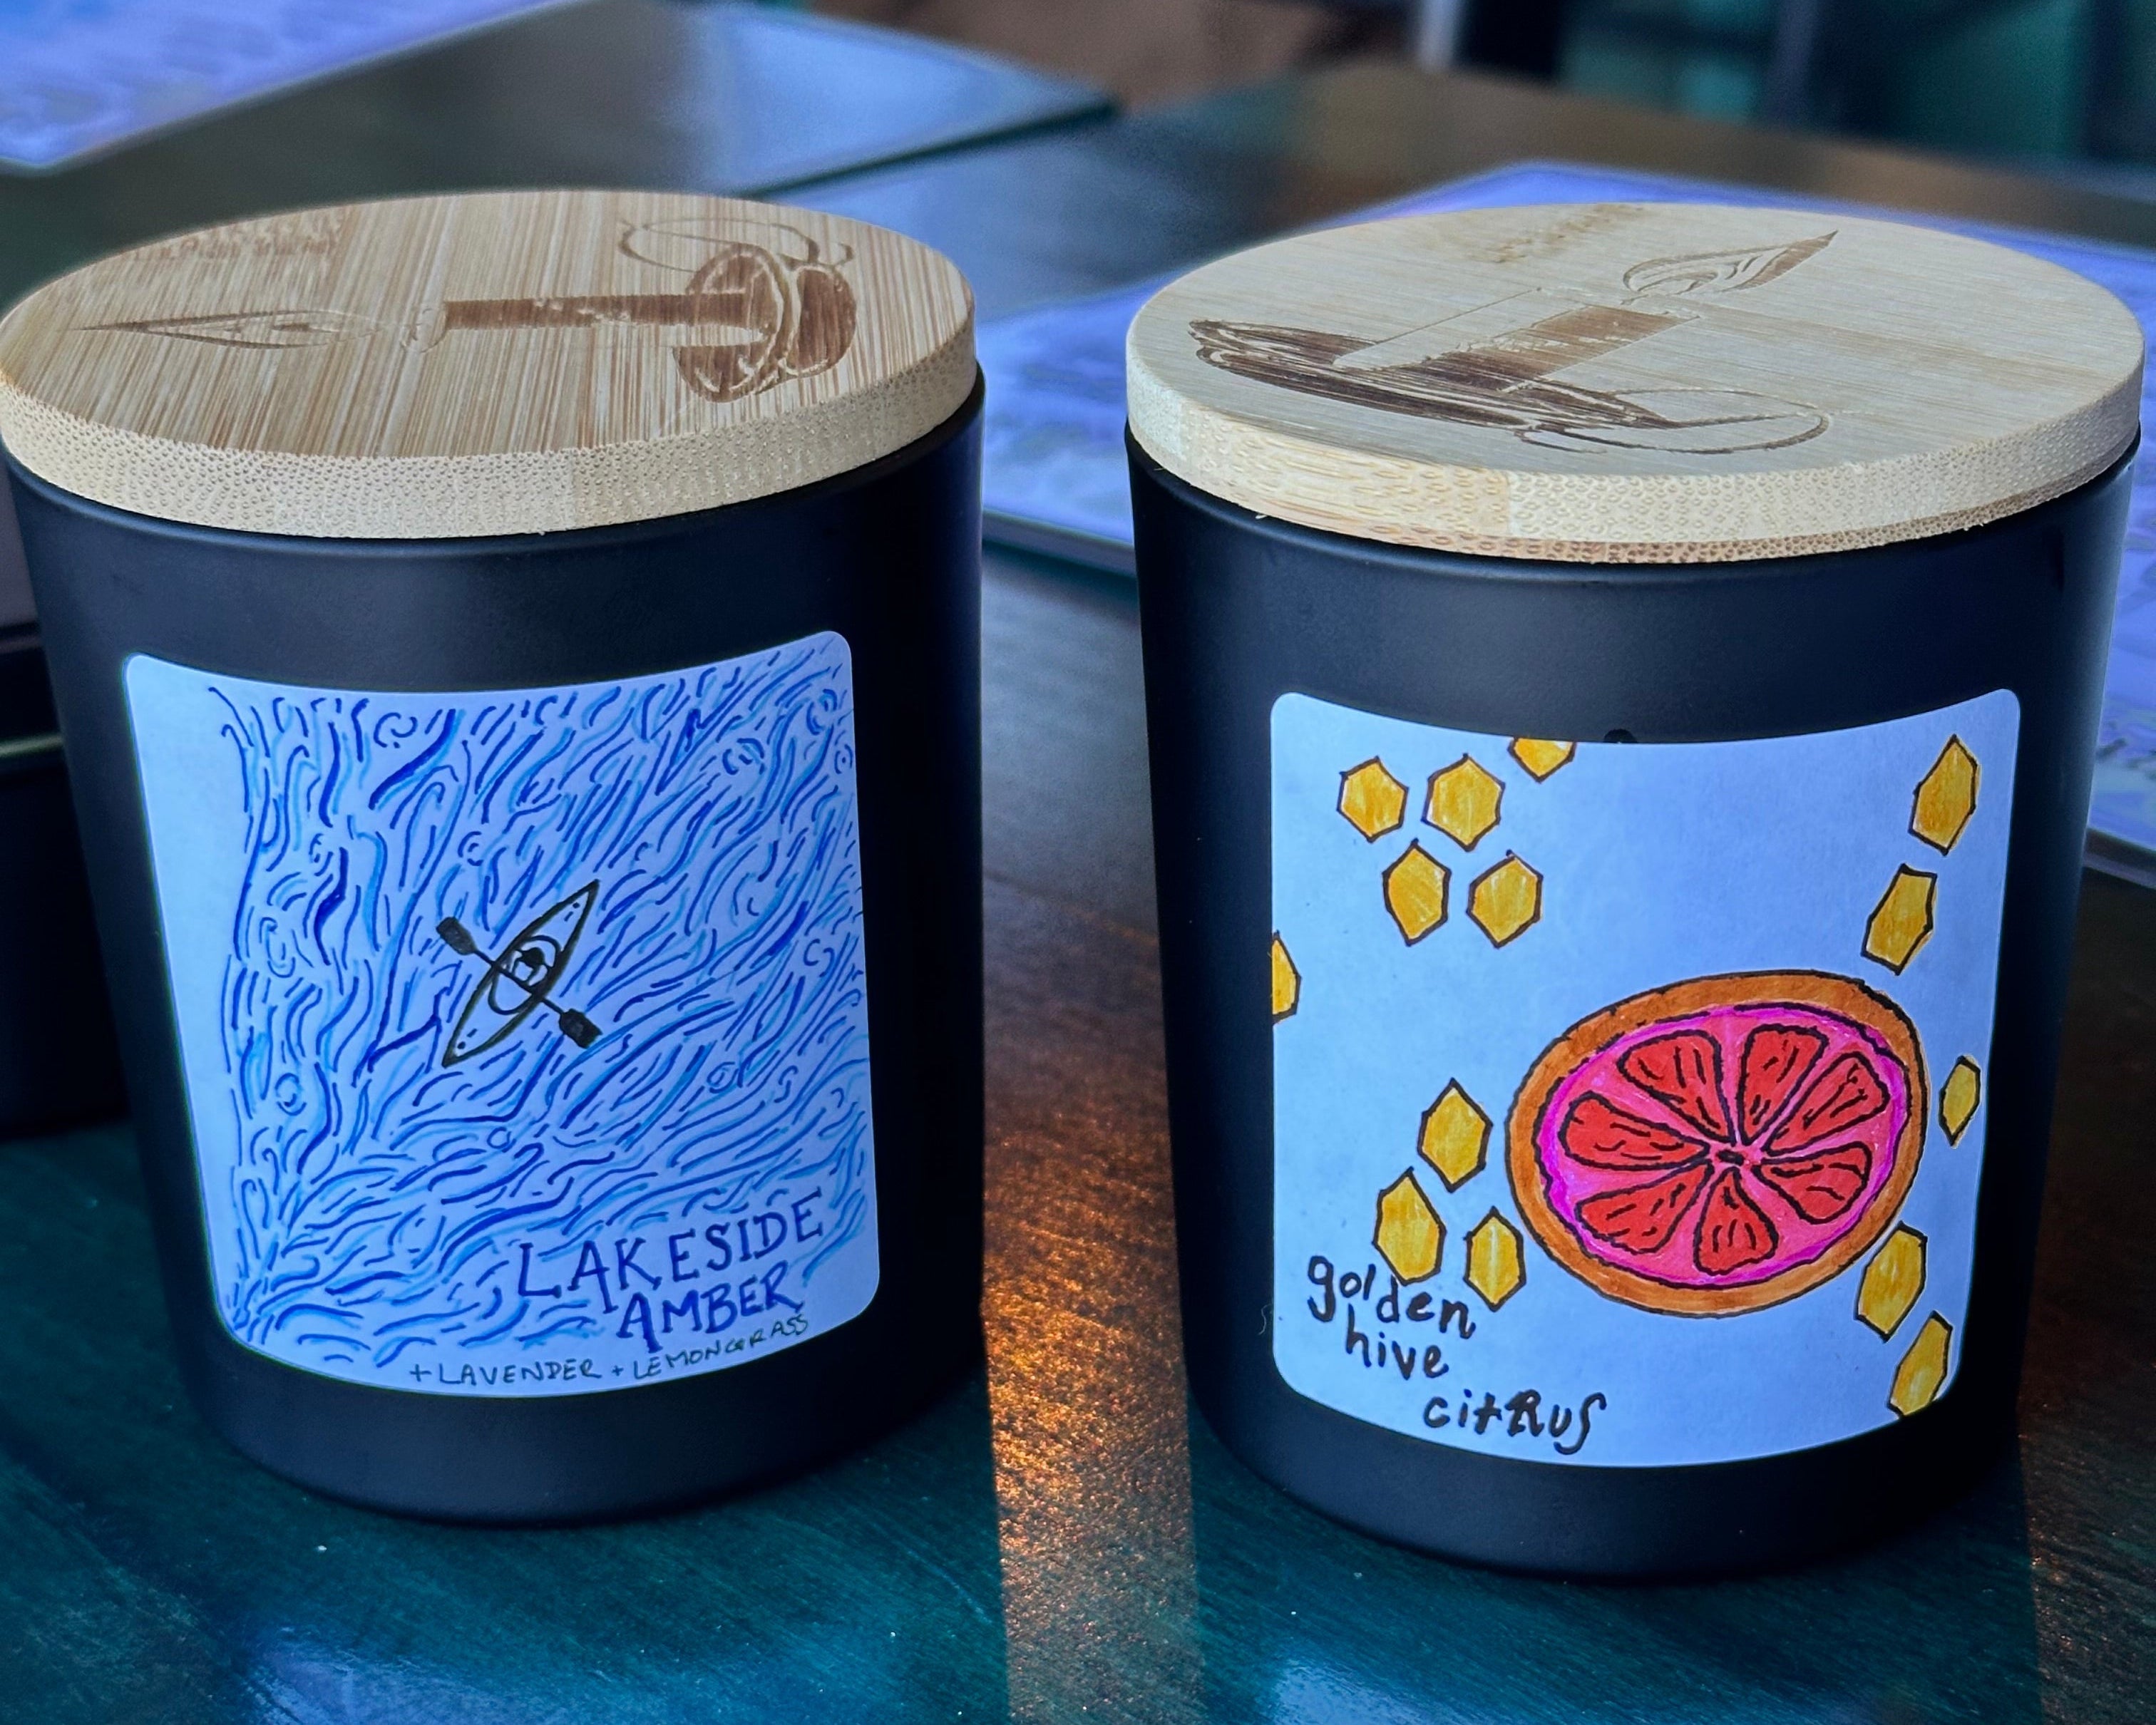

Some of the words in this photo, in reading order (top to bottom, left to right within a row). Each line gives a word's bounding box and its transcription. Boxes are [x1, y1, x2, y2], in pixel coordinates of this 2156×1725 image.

[518, 1185, 824, 1314] LAKESIDE
[615, 1260, 805, 1353] AMBER
[1308, 1255, 1477, 1339] golden
[438, 1358, 602, 1386] LAVENDER
[632, 1313, 809, 1379] LEMONGRASS
[1345, 1304, 1449, 1381] hive
